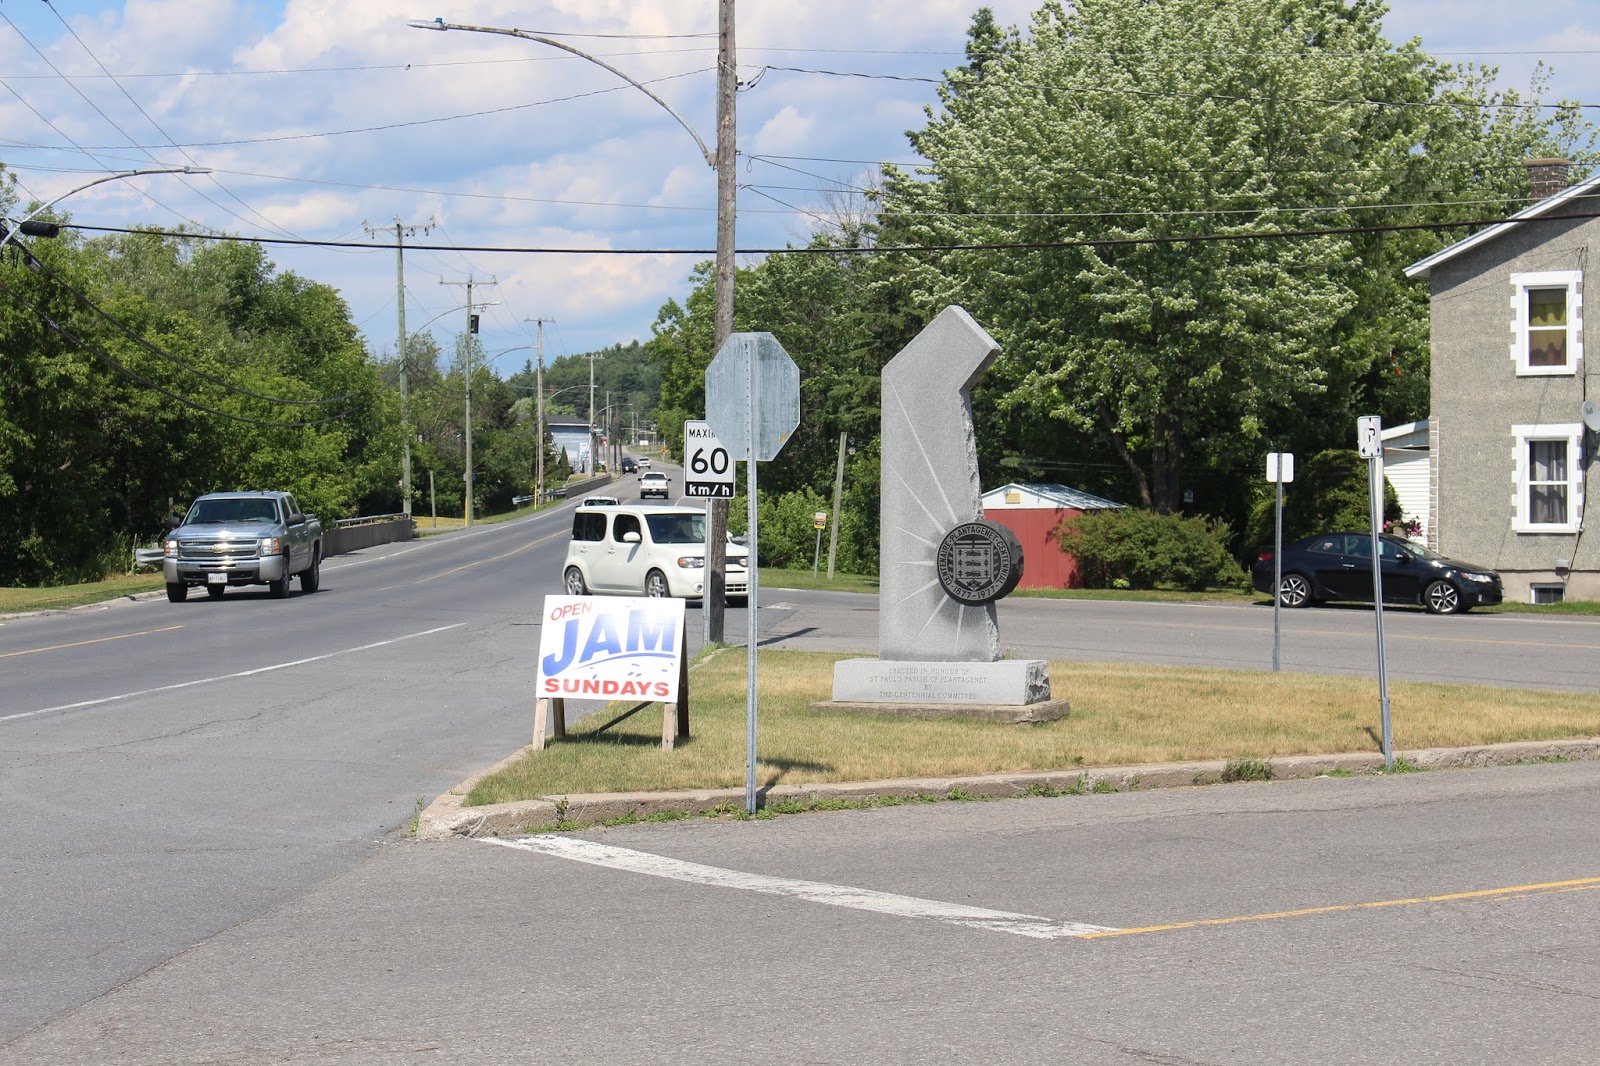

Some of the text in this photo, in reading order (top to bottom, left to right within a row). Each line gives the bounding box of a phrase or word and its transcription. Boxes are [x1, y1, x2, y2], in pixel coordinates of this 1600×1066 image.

[691, 447, 729, 475] 60
[689, 484, 730, 496] km/h
[950, 526, 998, 541] PLANTAGENET
[940, 540, 952, 586] CENTENAIRE
[996, 540, 1009, 586] CENTENNIAL
[953, 586, 996, 599] 1877-1977
[551, 602, 592, 621] OPEN
[543, 609, 676, 677] JAM
[544, 678, 669, 697] SUNDAYS
[904, 675, 928, 683] PARISH
[940, 676, 987, 684] PLANTAGENET
[894, 691, 936, 699] CENTENNIAL
[937, 692, 977, 700] COMMITTEE
